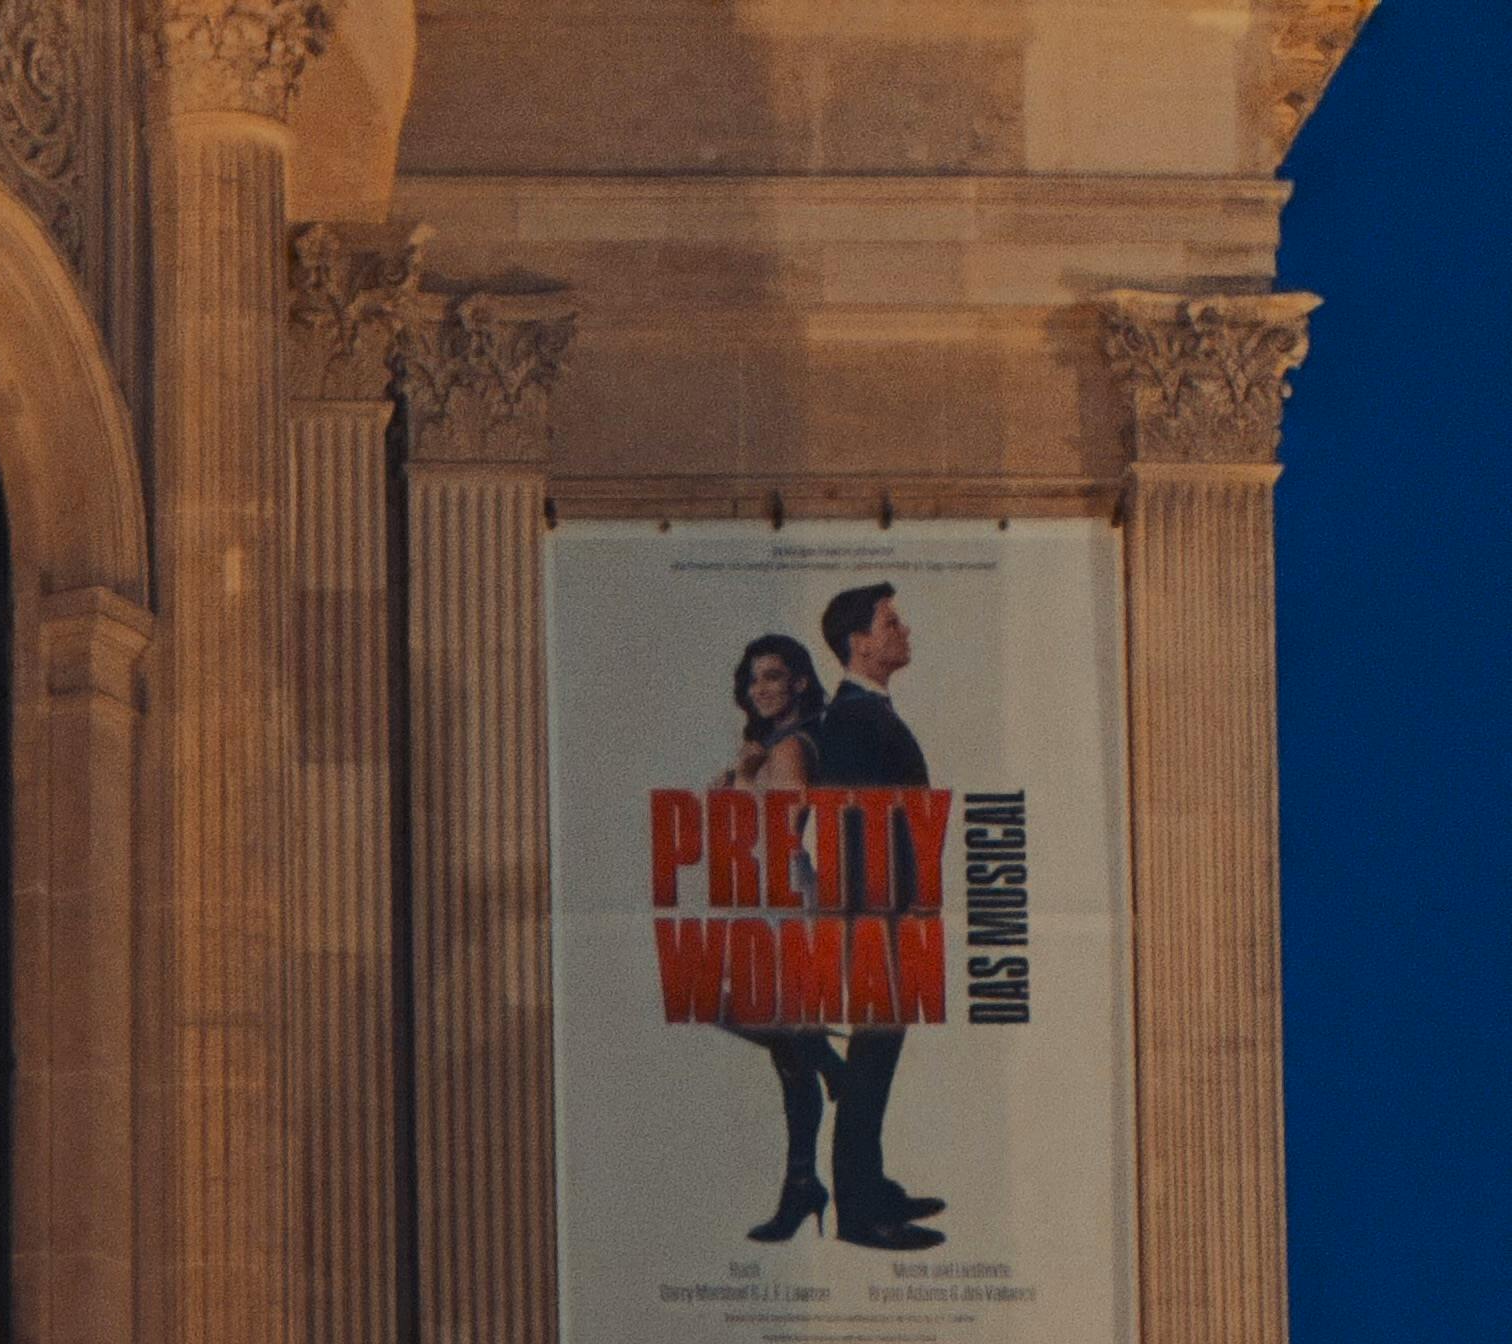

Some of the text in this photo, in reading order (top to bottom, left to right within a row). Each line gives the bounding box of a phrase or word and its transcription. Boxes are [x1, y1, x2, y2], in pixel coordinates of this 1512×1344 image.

[651, 788, 952, 908] PRETTY
[964, 789, 1030, 1025] DAS MUSICAL
[653, 916, 947, 1025] WOMAN
